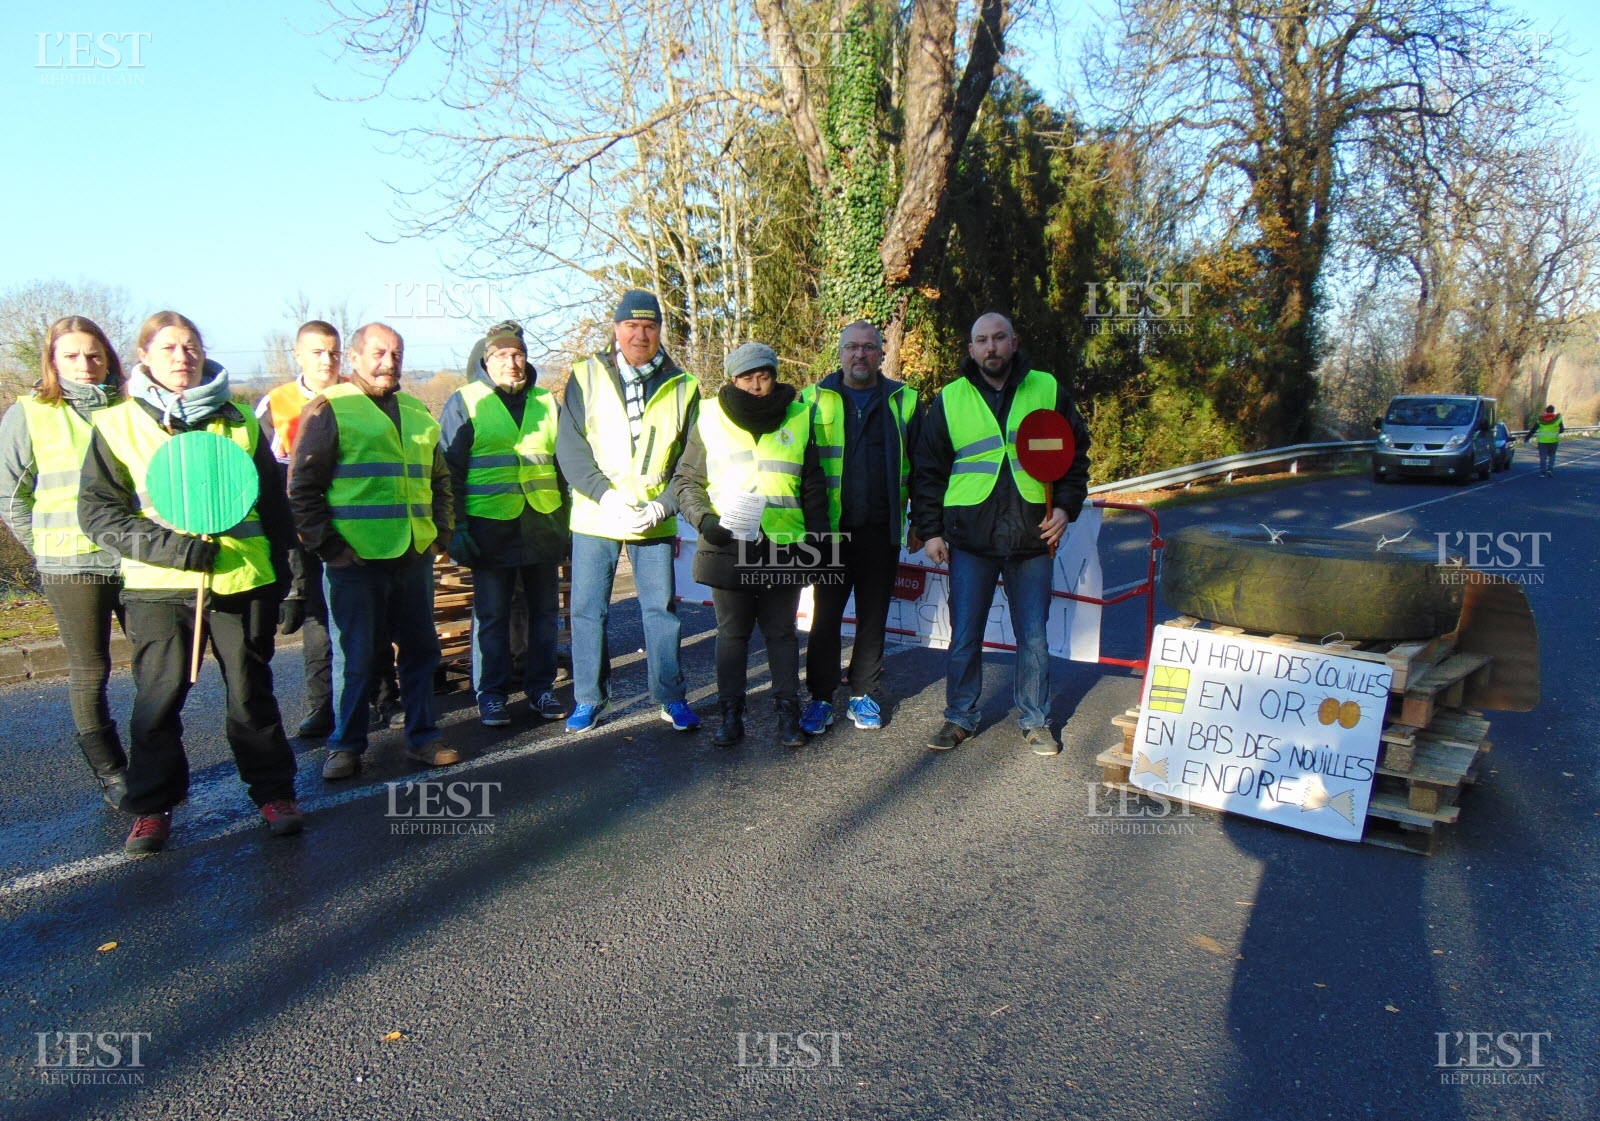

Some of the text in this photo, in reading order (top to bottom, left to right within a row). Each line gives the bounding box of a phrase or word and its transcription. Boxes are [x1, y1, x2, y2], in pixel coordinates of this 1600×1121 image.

[1161, 638, 1199, 664] EN
[1208, 643, 1272, 675] HAUT
[1274, 654, 1312, 684] DES
[1199, 681, 1306, 726] EN OR
[1145, 716, 1176, 746] EN
[1188, 722, 1233, 754] BAS
[1237, 732, 1282, 763] DES
[1182, 760, 1301, 805] ENCORE
